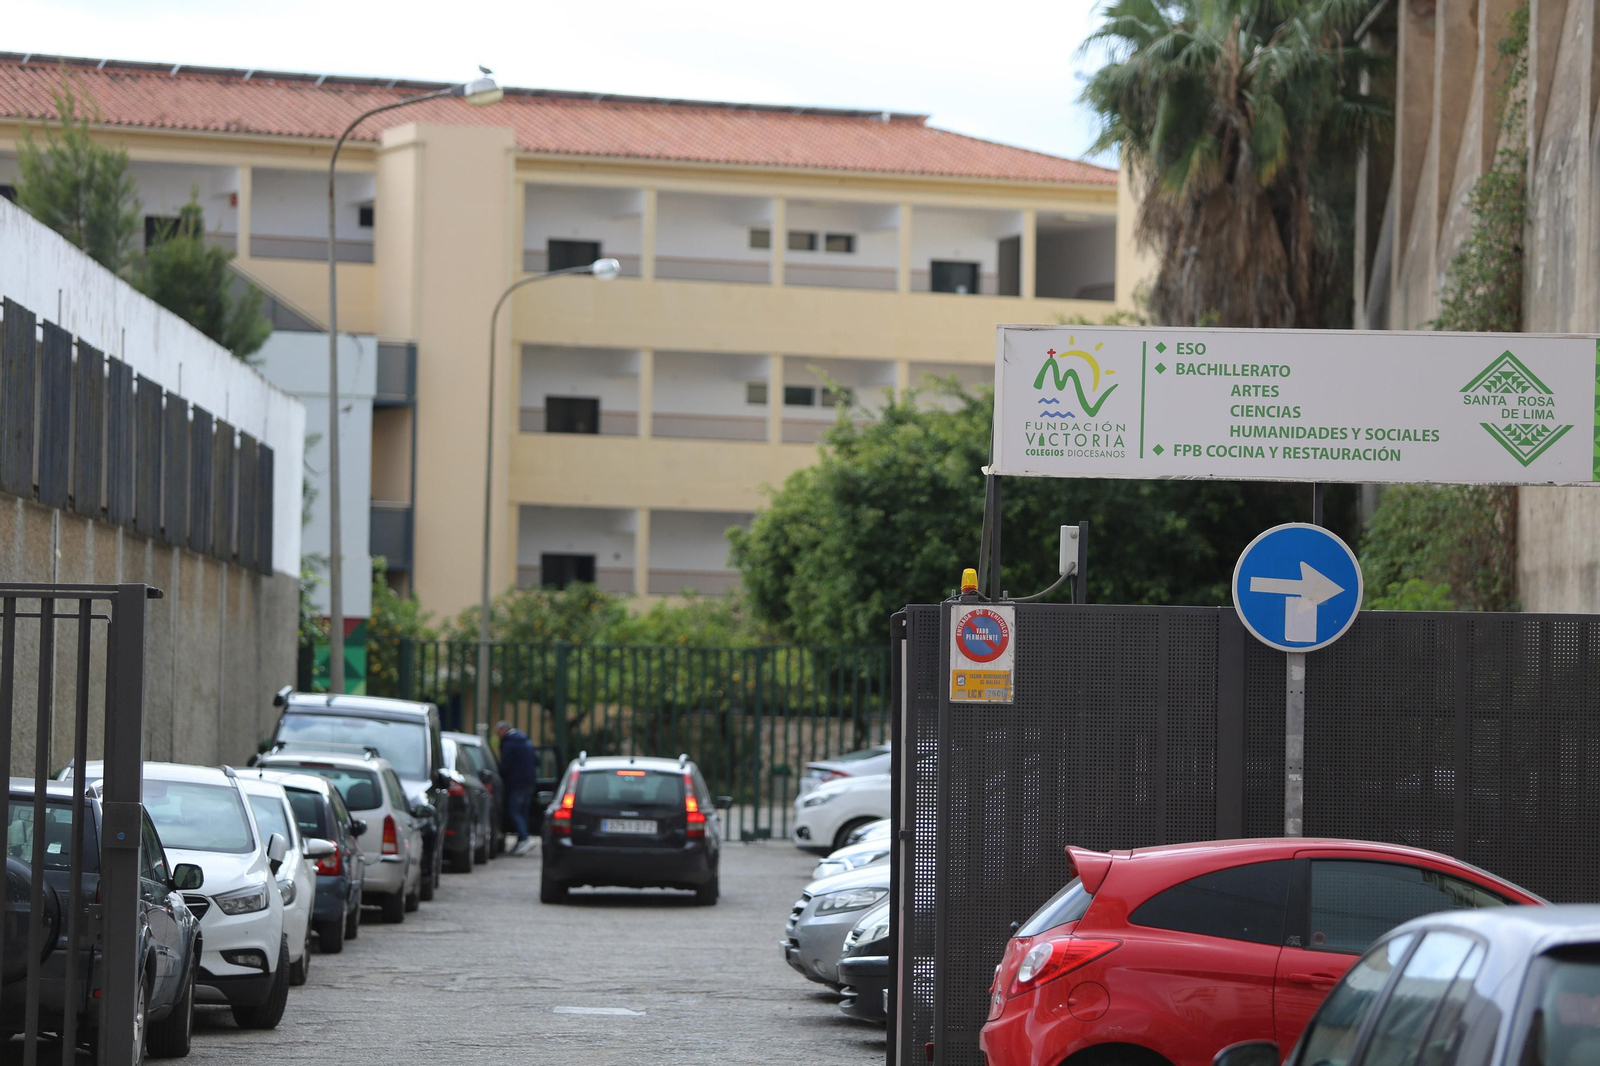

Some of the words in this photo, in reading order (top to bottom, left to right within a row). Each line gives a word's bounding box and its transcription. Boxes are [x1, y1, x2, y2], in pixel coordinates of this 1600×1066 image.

[1177, 341, 1207, 356] ESO
[1175, 362, 1291, 378] BACHILLERATO
[1230, 384, 1280, 398] ARTES
[1463, 394, 1507, 406] SANTA
[1517, 396, 1556, 407] ROSA
[1229, 404, 1302, 419] CIENCIAS
[1501, 408, 1519, 419] DE
[1523, 409, 1555, 420] LIMA
[1025, 421, 1127, 432] FUNDACIÓN
[1229, 425, 1348, 441] HUMANIDADES
[1352, 427, 1361, 441] Y
[1365, 428, 1441, 443] SOCIALES
[1025, 432, 1126, 448] VICTORIA
[1025, 448, 1065, 457] COLEGIOS
[1067, 449, 1126, 459] DIOCESANOS
[1173, 443, 1202, 457] FPB
[1205, 444, 1265, 459] COCINA
[1268, 446, 1278, 459] Y
[1282, 445, 1402, 462] RESTAURACIÓN
[957, 613, 972, 636] ENTRADA
